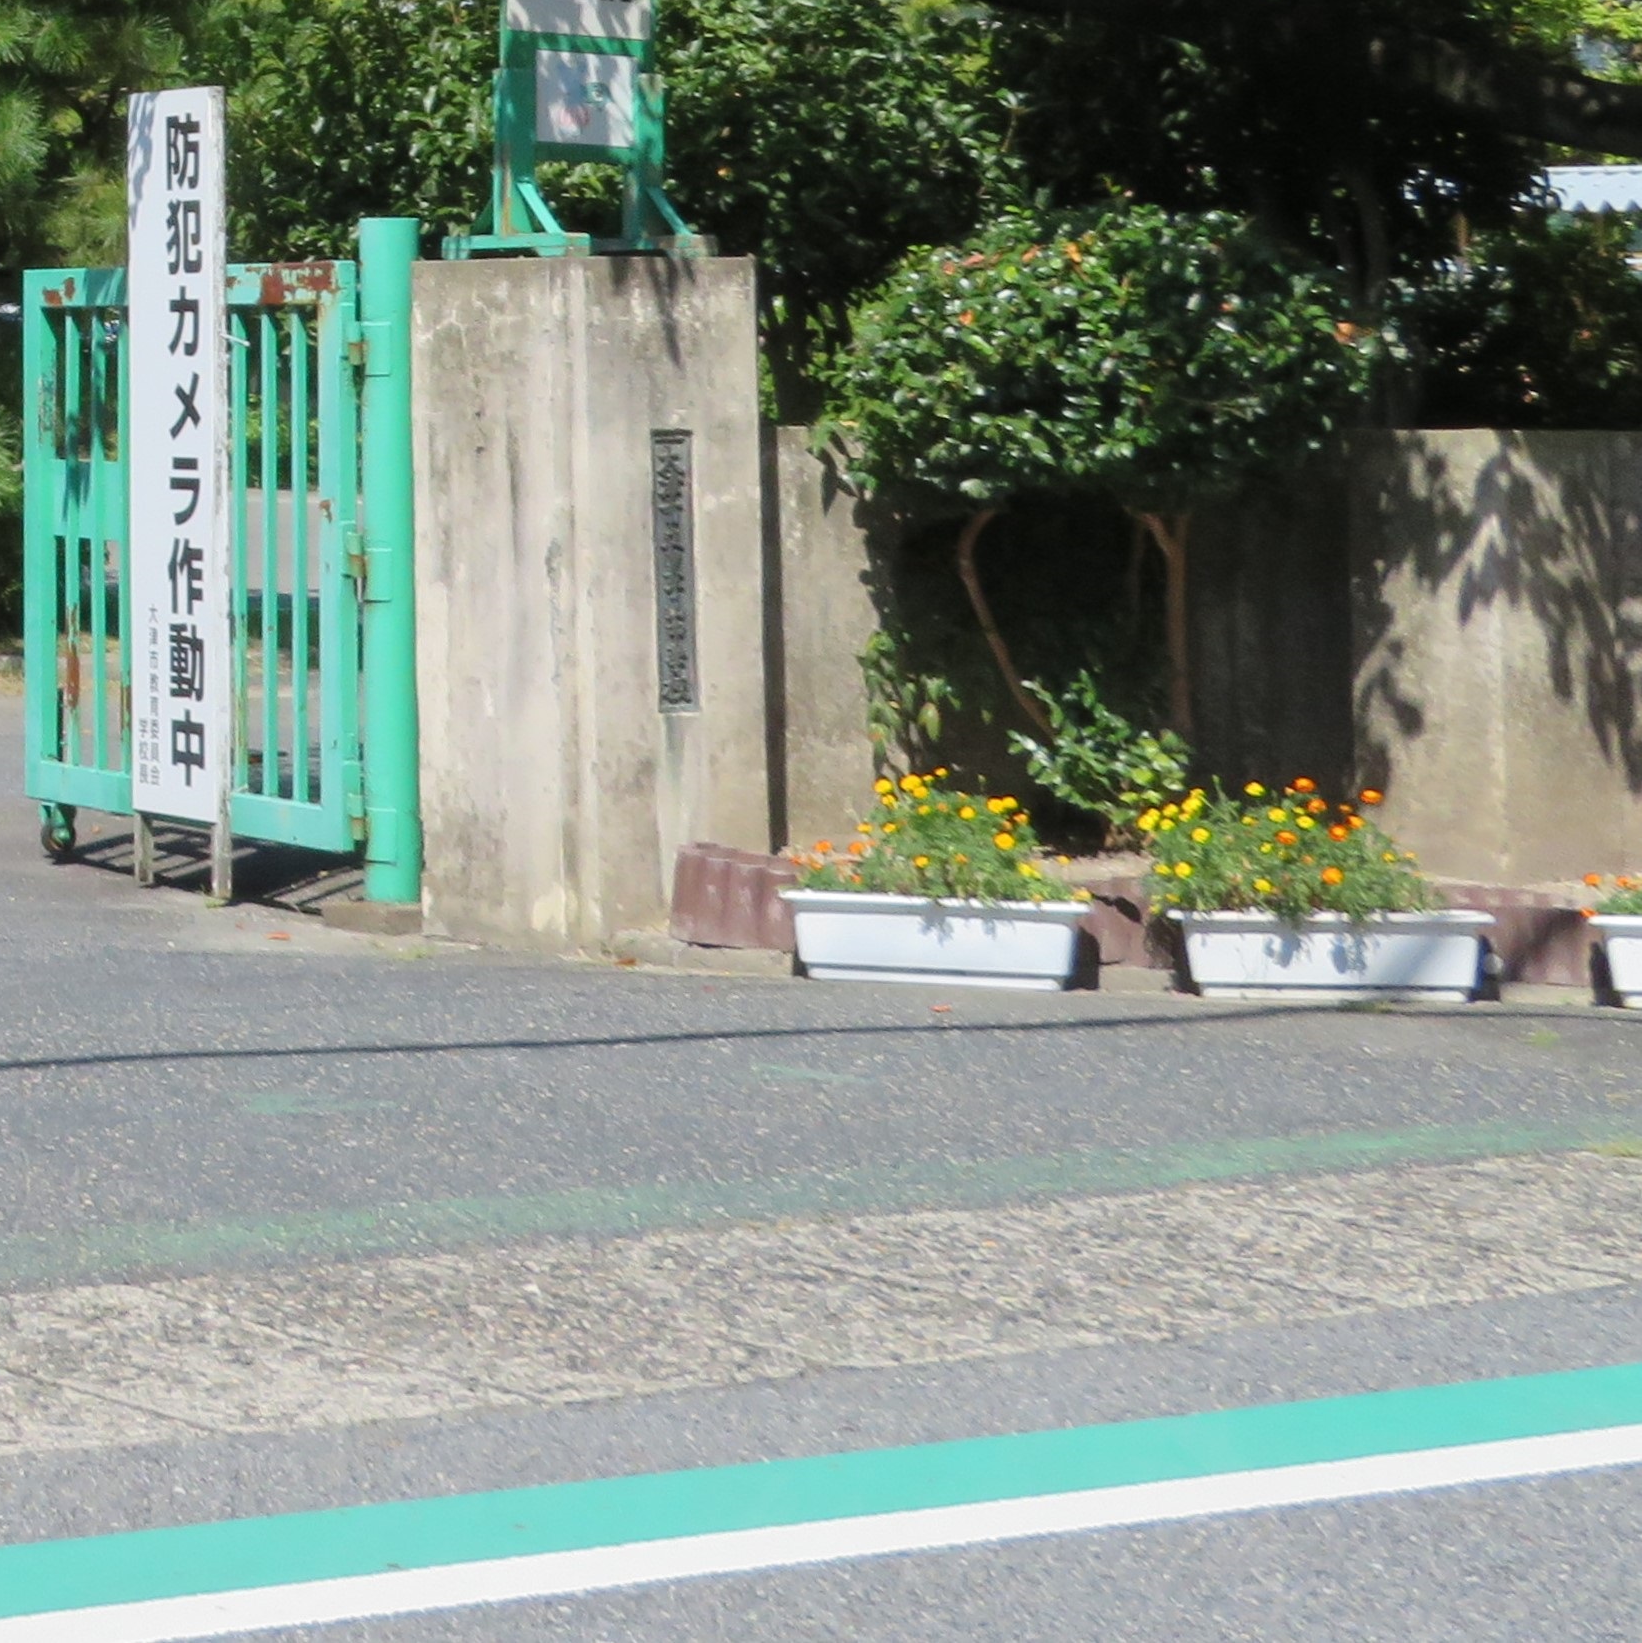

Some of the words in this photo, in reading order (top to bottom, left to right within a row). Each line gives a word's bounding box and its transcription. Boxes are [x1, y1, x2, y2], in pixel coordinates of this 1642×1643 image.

[165, 112, 206, 787] 防犯カメラ作動中
